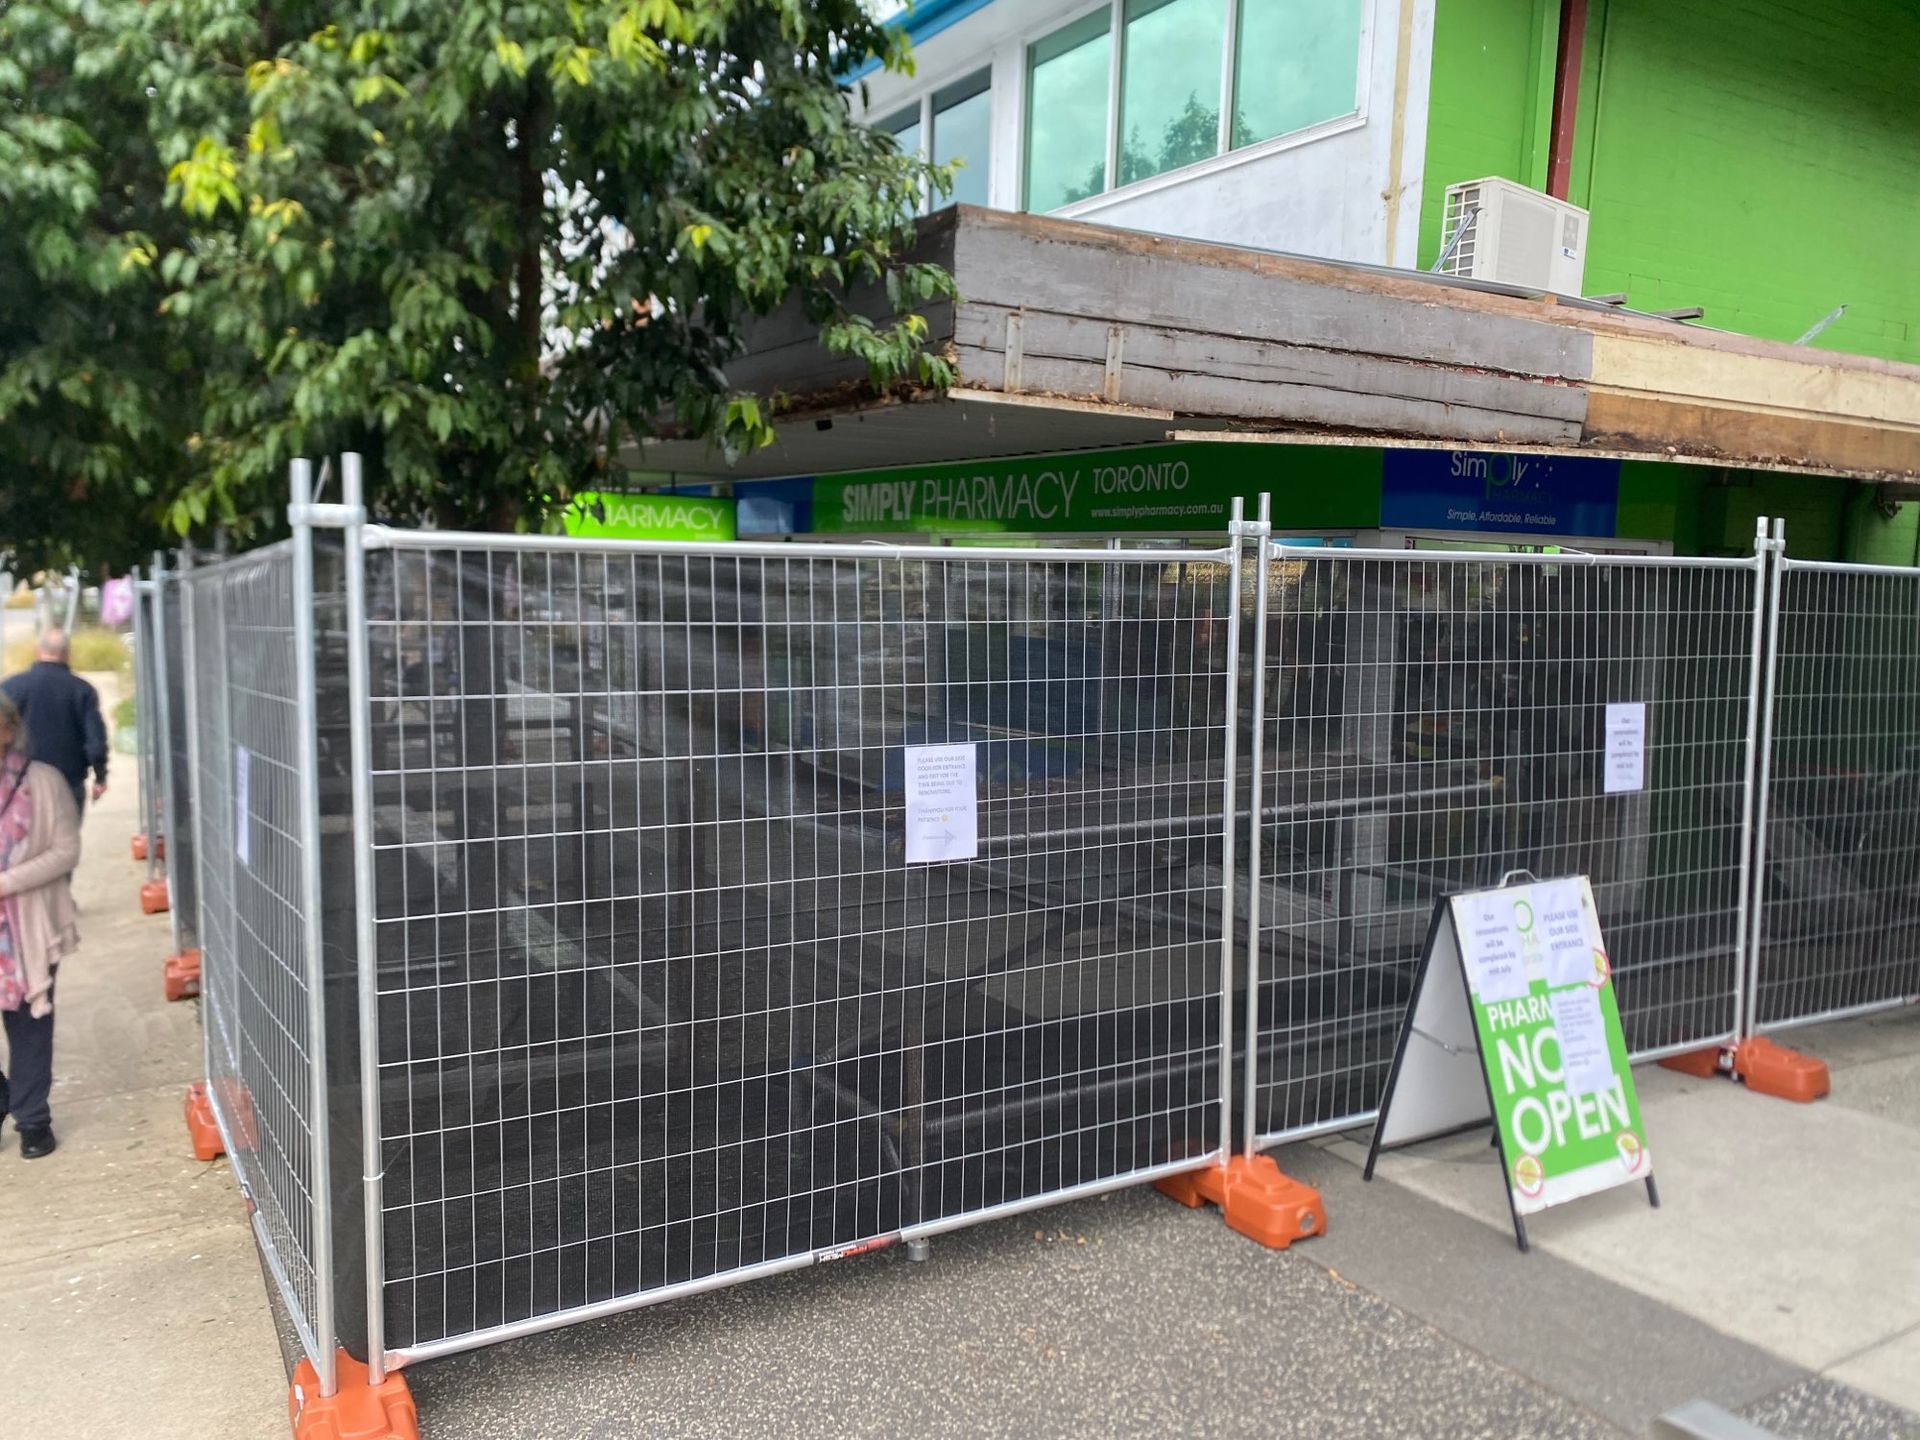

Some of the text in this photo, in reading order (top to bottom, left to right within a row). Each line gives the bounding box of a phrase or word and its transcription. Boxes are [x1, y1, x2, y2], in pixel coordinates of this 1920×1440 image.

[1092, 461, 1190, 495] TORONTO
[1451, 451, 1528, 499] Simply
[843, 469, 1080, 523] SIMPLY PHARMACY
[1091, 503, 1224, 519] www.simplypharmacy.com.au
[597, 503, 725, 530] HARMACY
[1524, 513, 1557, 526] Reliable
[1543, 910, 1566, 922] PLEASE
[1548, 925, 1564, 936] OUR
[1496, 1027, 1564, 1095] NO
[1511, 1073, 1631, 1156] OPEN
